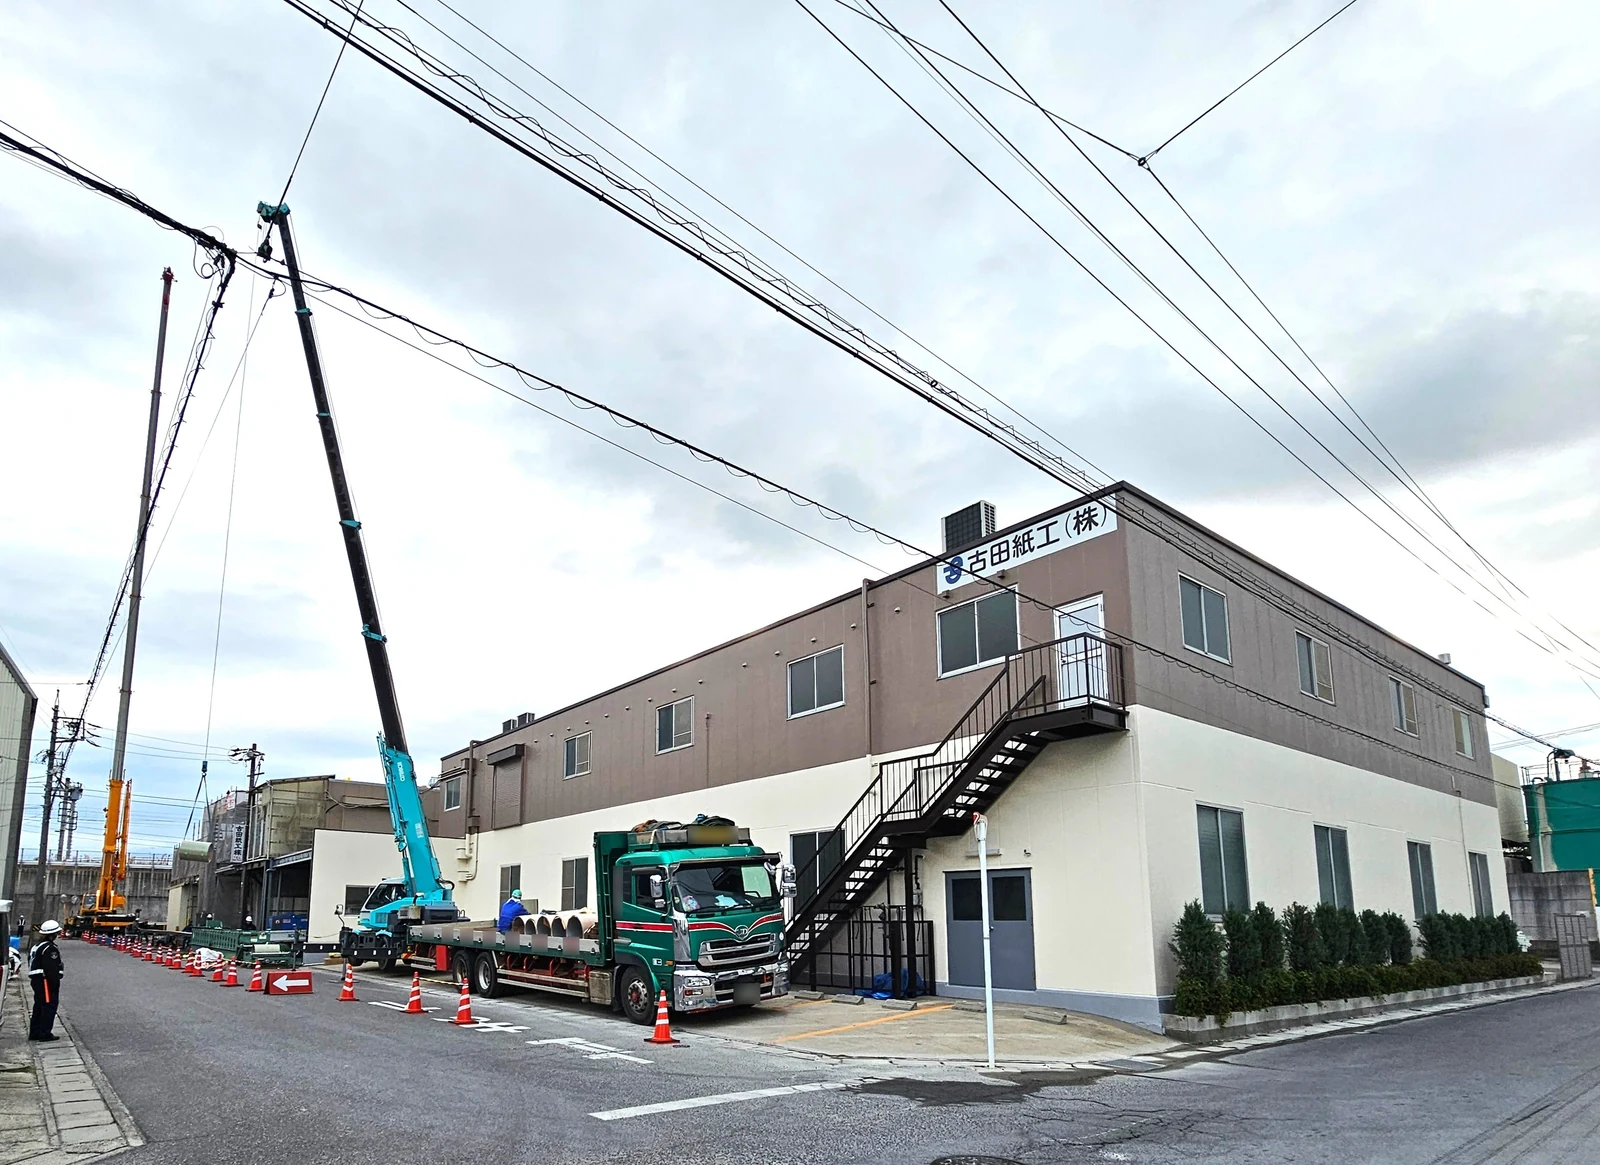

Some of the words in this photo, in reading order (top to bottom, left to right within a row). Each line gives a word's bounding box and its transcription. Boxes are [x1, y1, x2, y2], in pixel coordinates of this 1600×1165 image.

[968, 505, 1107, 574] 古田紙工(株)
